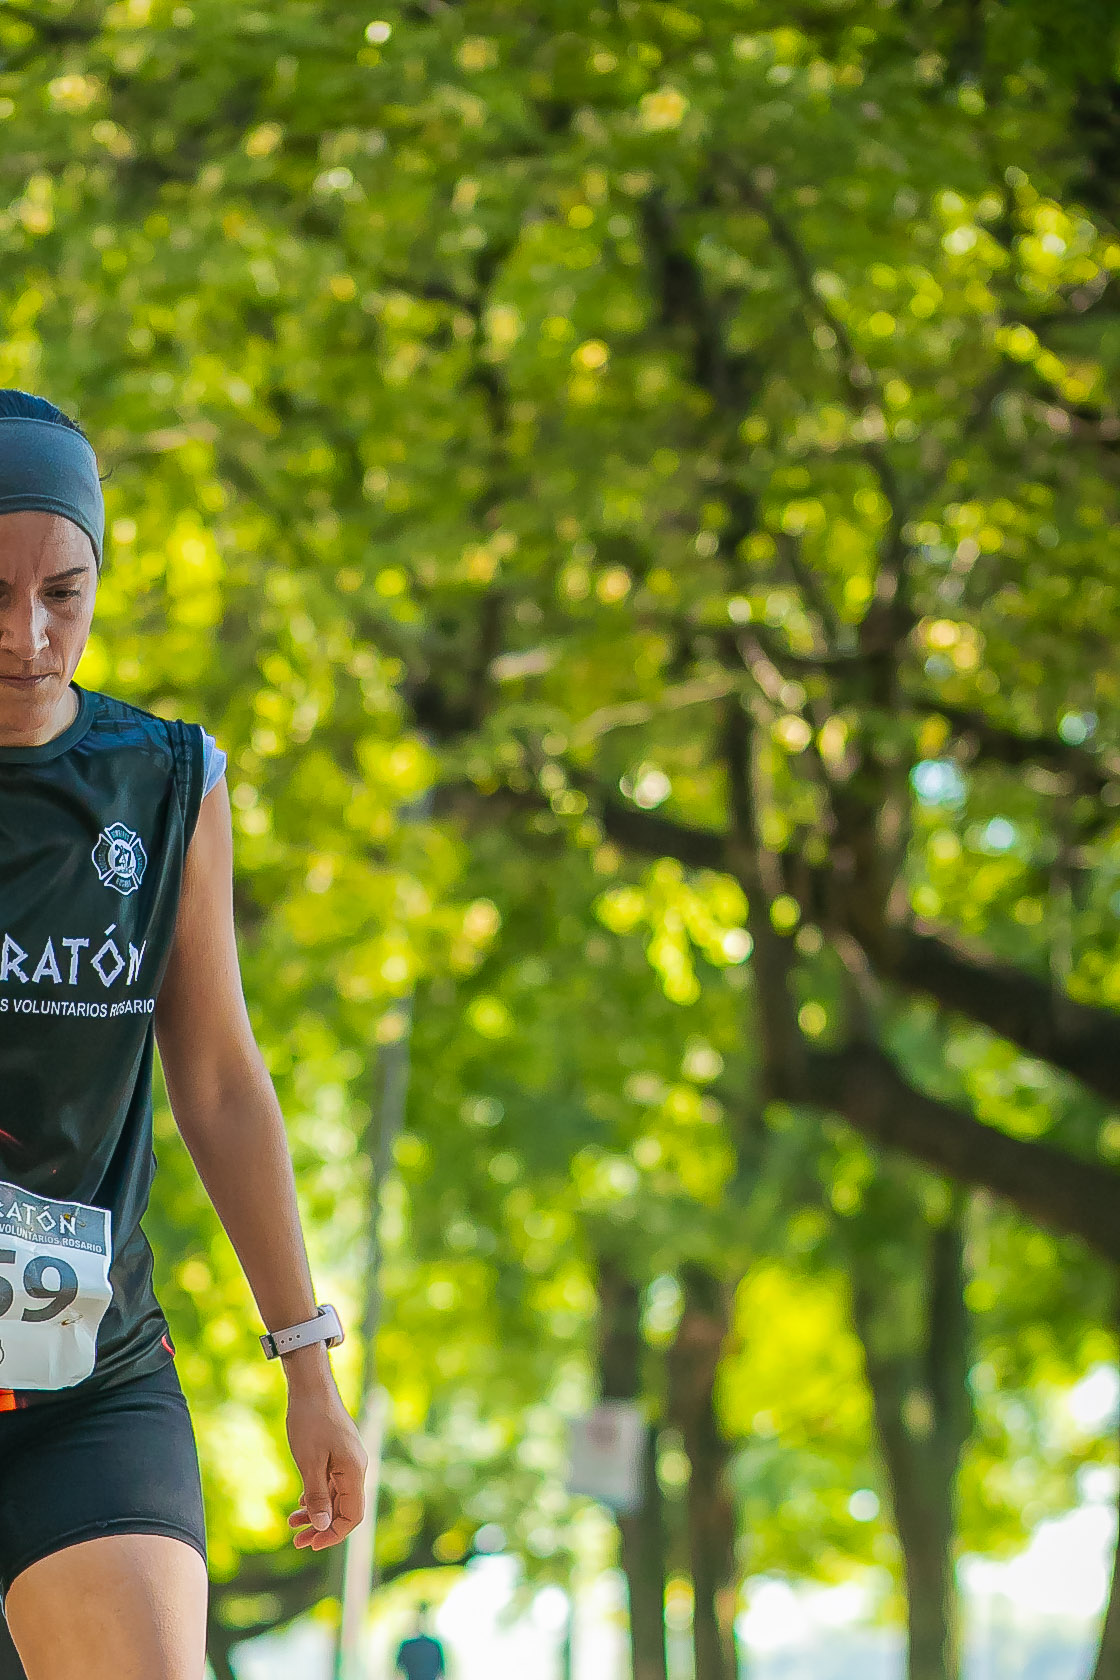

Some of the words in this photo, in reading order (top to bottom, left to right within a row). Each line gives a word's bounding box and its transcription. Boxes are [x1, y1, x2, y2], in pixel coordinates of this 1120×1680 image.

[13, 998, 108, 1018] VOLUNTARIOS
[109, 998, 155, 1018] ROSARIO
[0, 1222, 60, 1245] VOLUNTARIOS
[62, 1237, 103, 1253] ROSARIO
